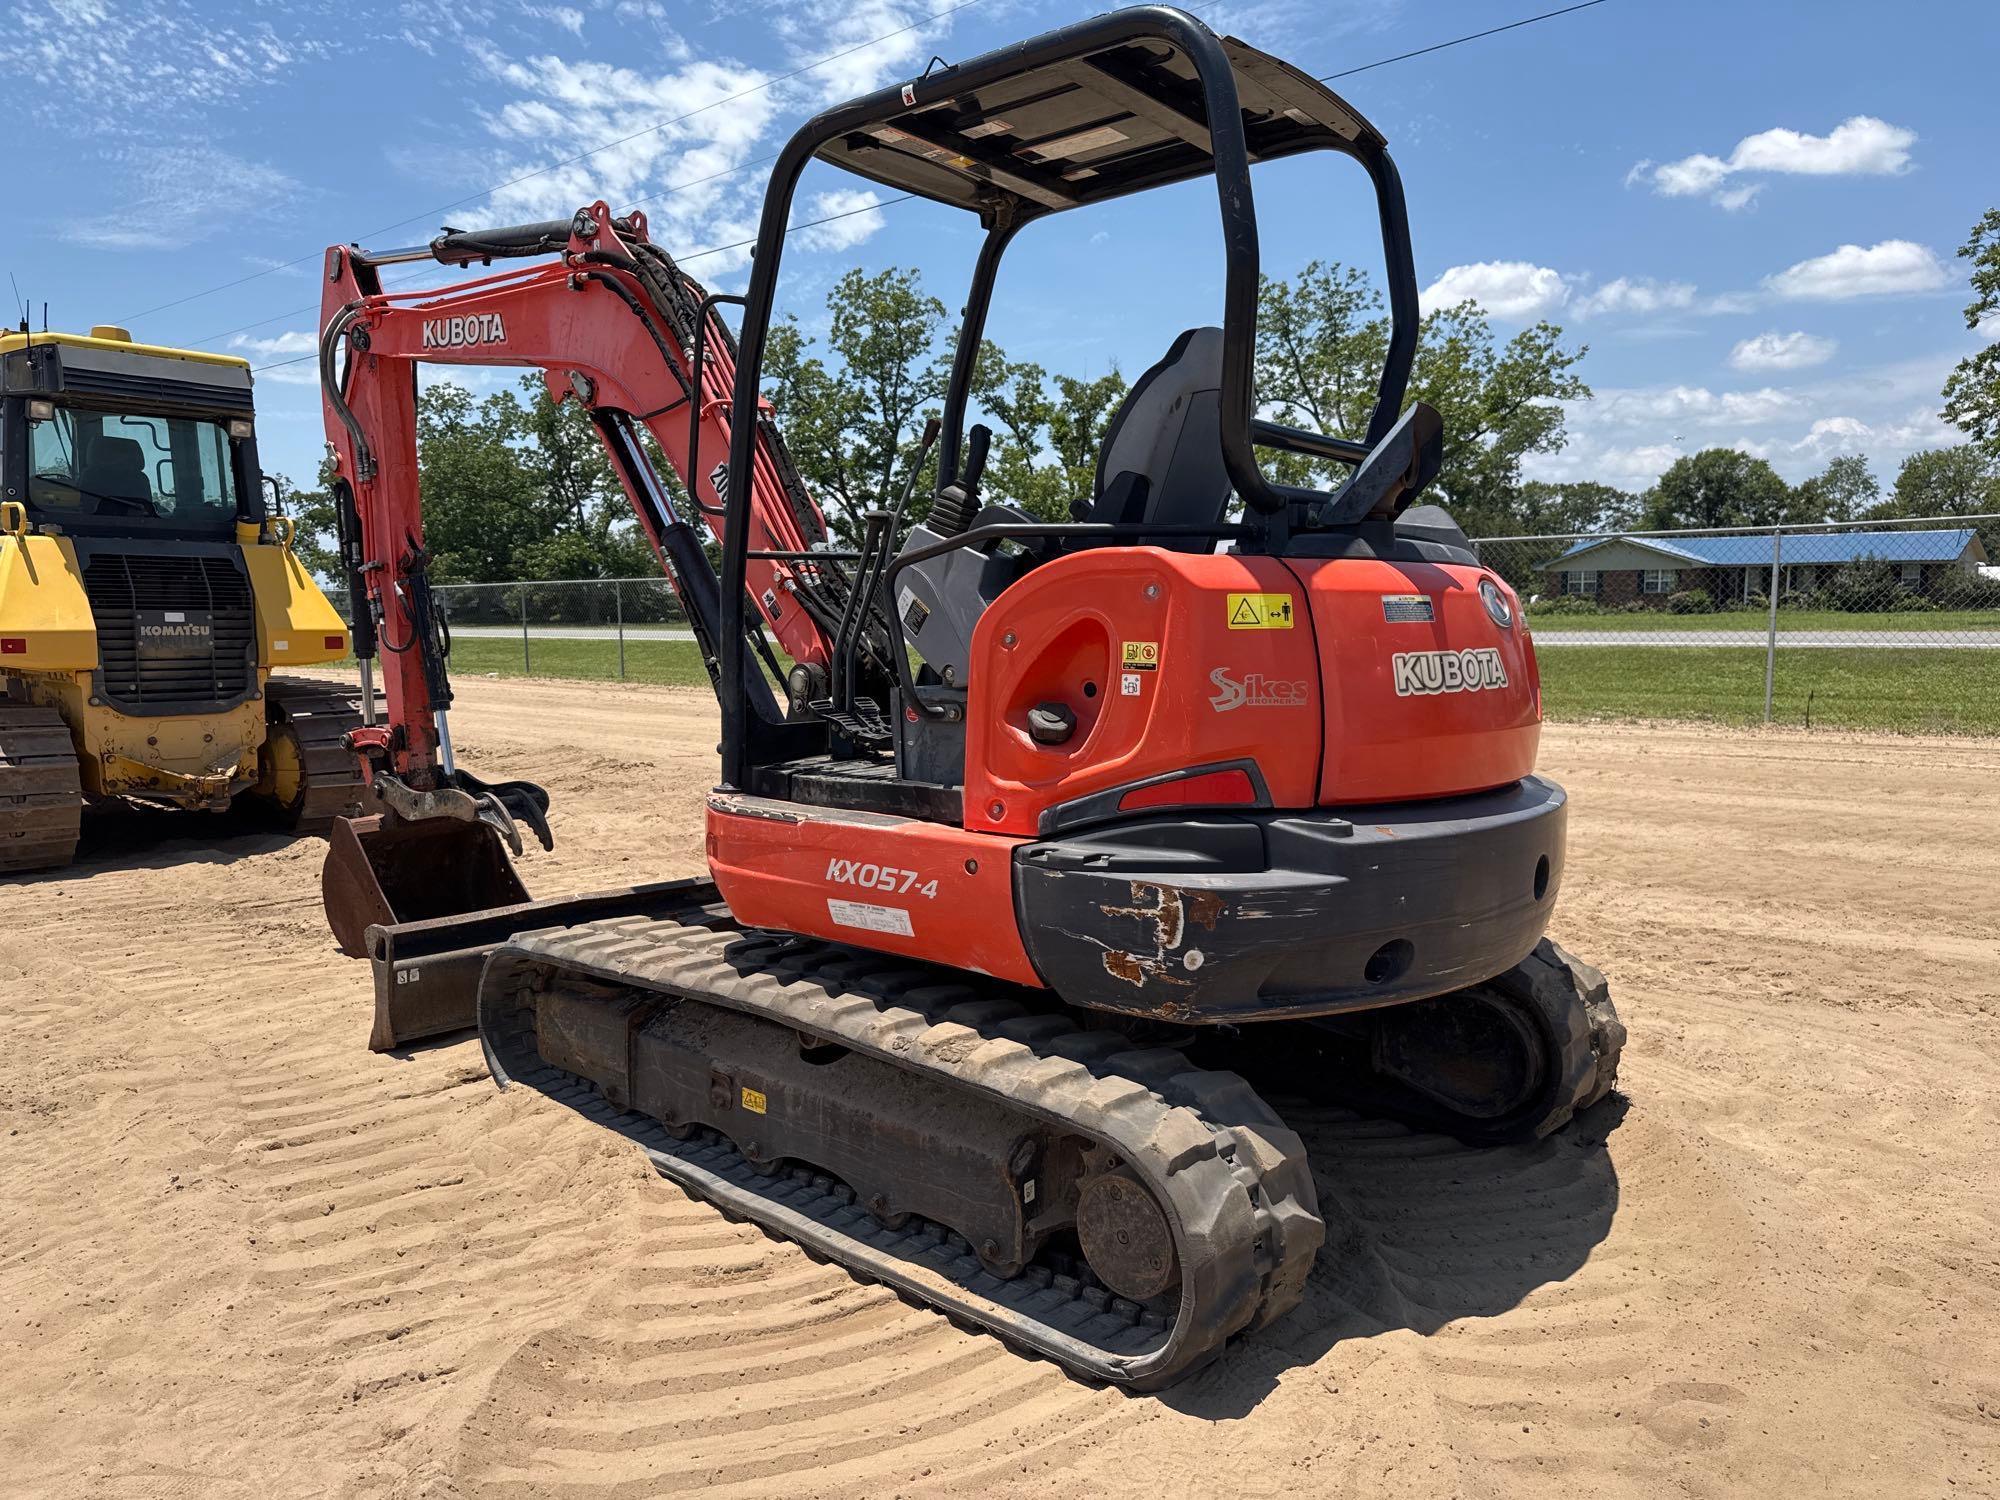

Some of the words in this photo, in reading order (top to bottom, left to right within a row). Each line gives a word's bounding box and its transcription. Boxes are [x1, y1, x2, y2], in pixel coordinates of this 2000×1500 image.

[422, 313, 506, 349] KUBOTA
[140, 624, 210, 636] KOMATSU
[1208, 667, 1309, 712] Sikes
[1394, 649, 1508, 694] KUBOTA
[825, 858, 939, 899] KX057-4
